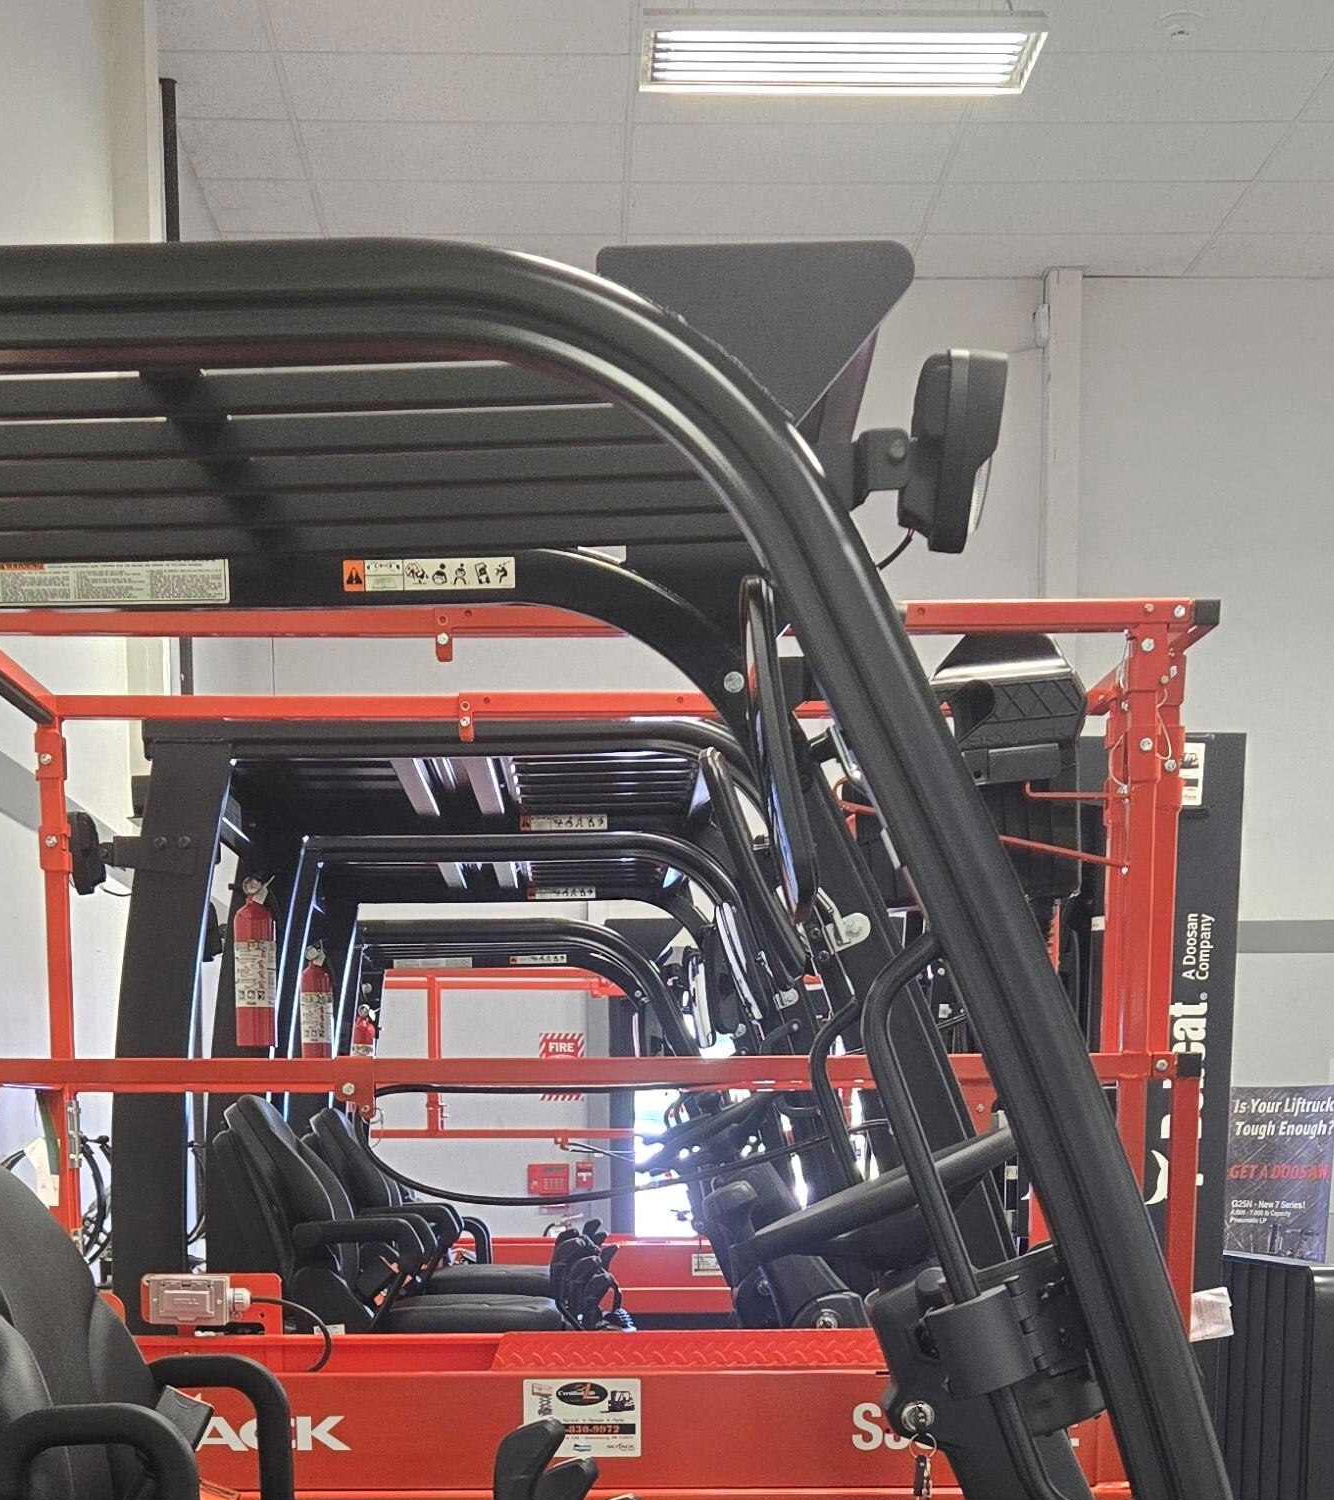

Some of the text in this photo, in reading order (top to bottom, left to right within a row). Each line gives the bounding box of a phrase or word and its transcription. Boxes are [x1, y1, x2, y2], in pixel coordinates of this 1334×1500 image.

[1182, 913, 1198, 980] A Doosan
[1195, 913, 1215, 981] Company
[548, 1042, 575, 1053] FIRE
[1233, 1099, 1248, 1114] Is
[1250, 1098, 1282, 1114] Your
[1235, 1119, 1334, 1140] Tough Enough?
[1229, 1164, 1330, 1180] GET A DOOSAN
[1258, 1200, 1275, 1209] New
[1280, 1200, 1306, 1210] Series!
